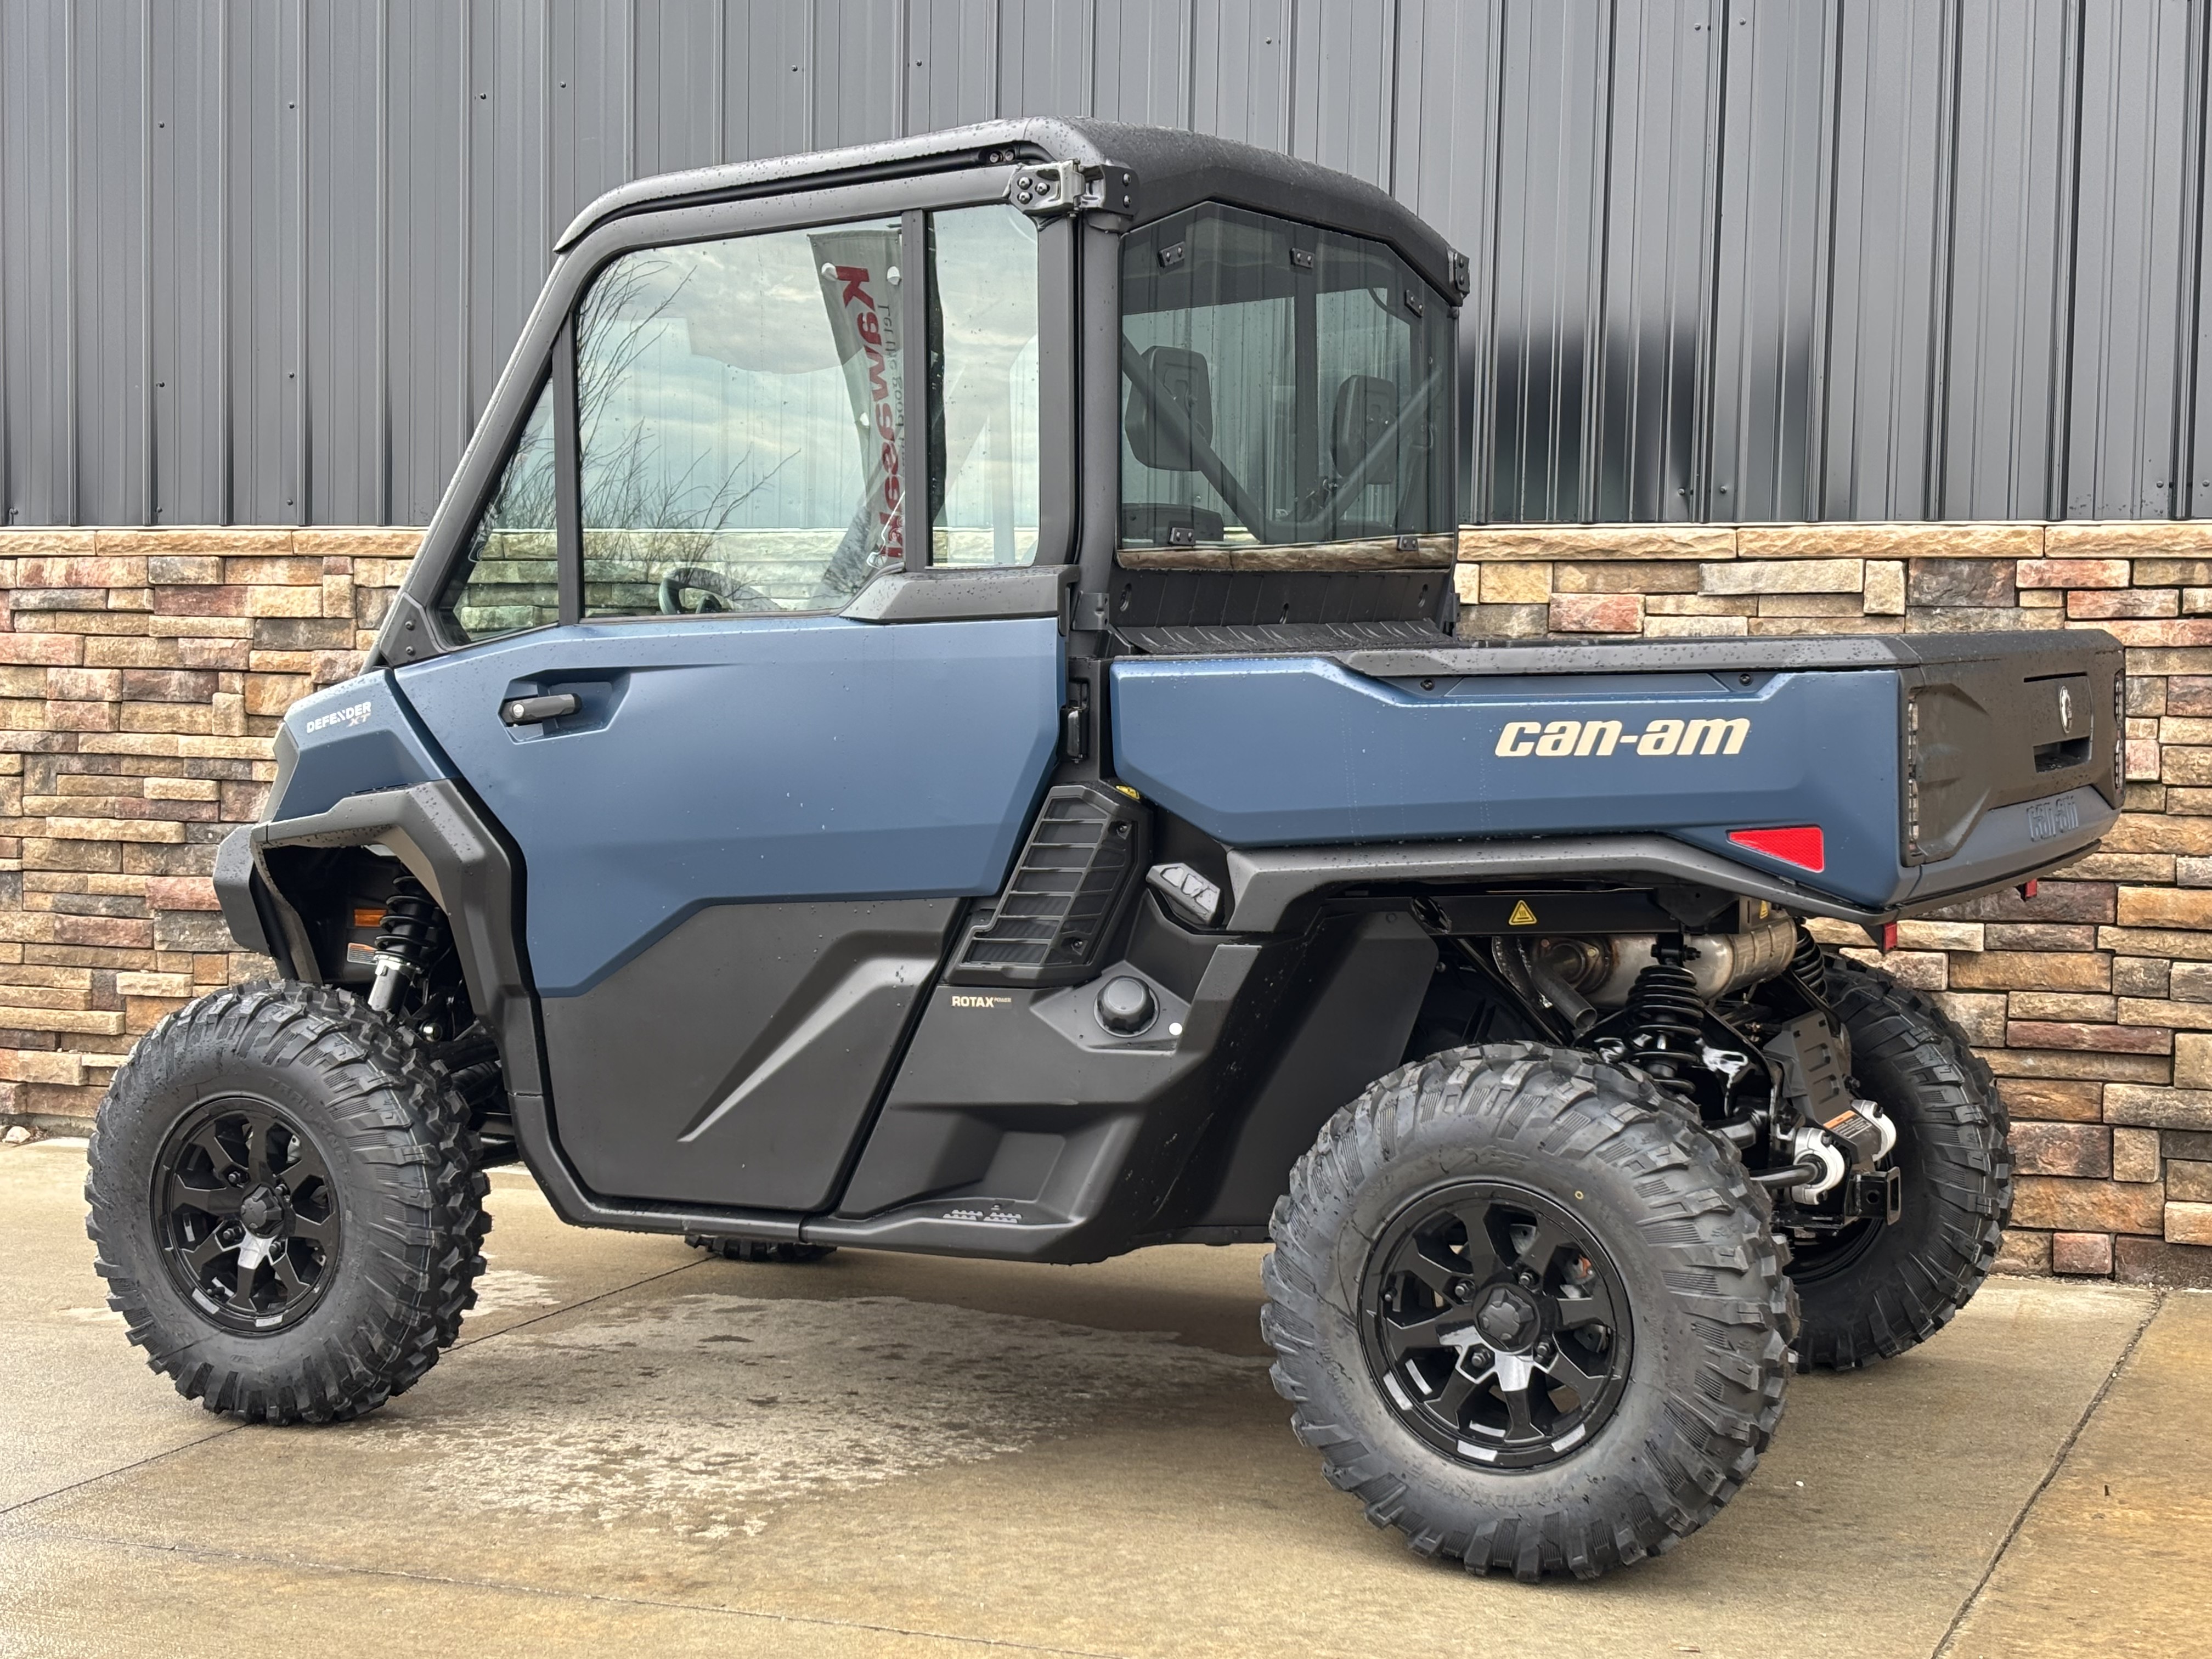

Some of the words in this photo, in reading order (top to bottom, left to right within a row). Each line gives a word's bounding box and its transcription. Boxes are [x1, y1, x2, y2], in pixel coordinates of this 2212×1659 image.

[307, 701, 371, 733] DEFENDER
[348, 713, 371, 727] XT
[1494, 718, 1750, 757] can-am
[952, 996, 994, 1008] ROTAX
